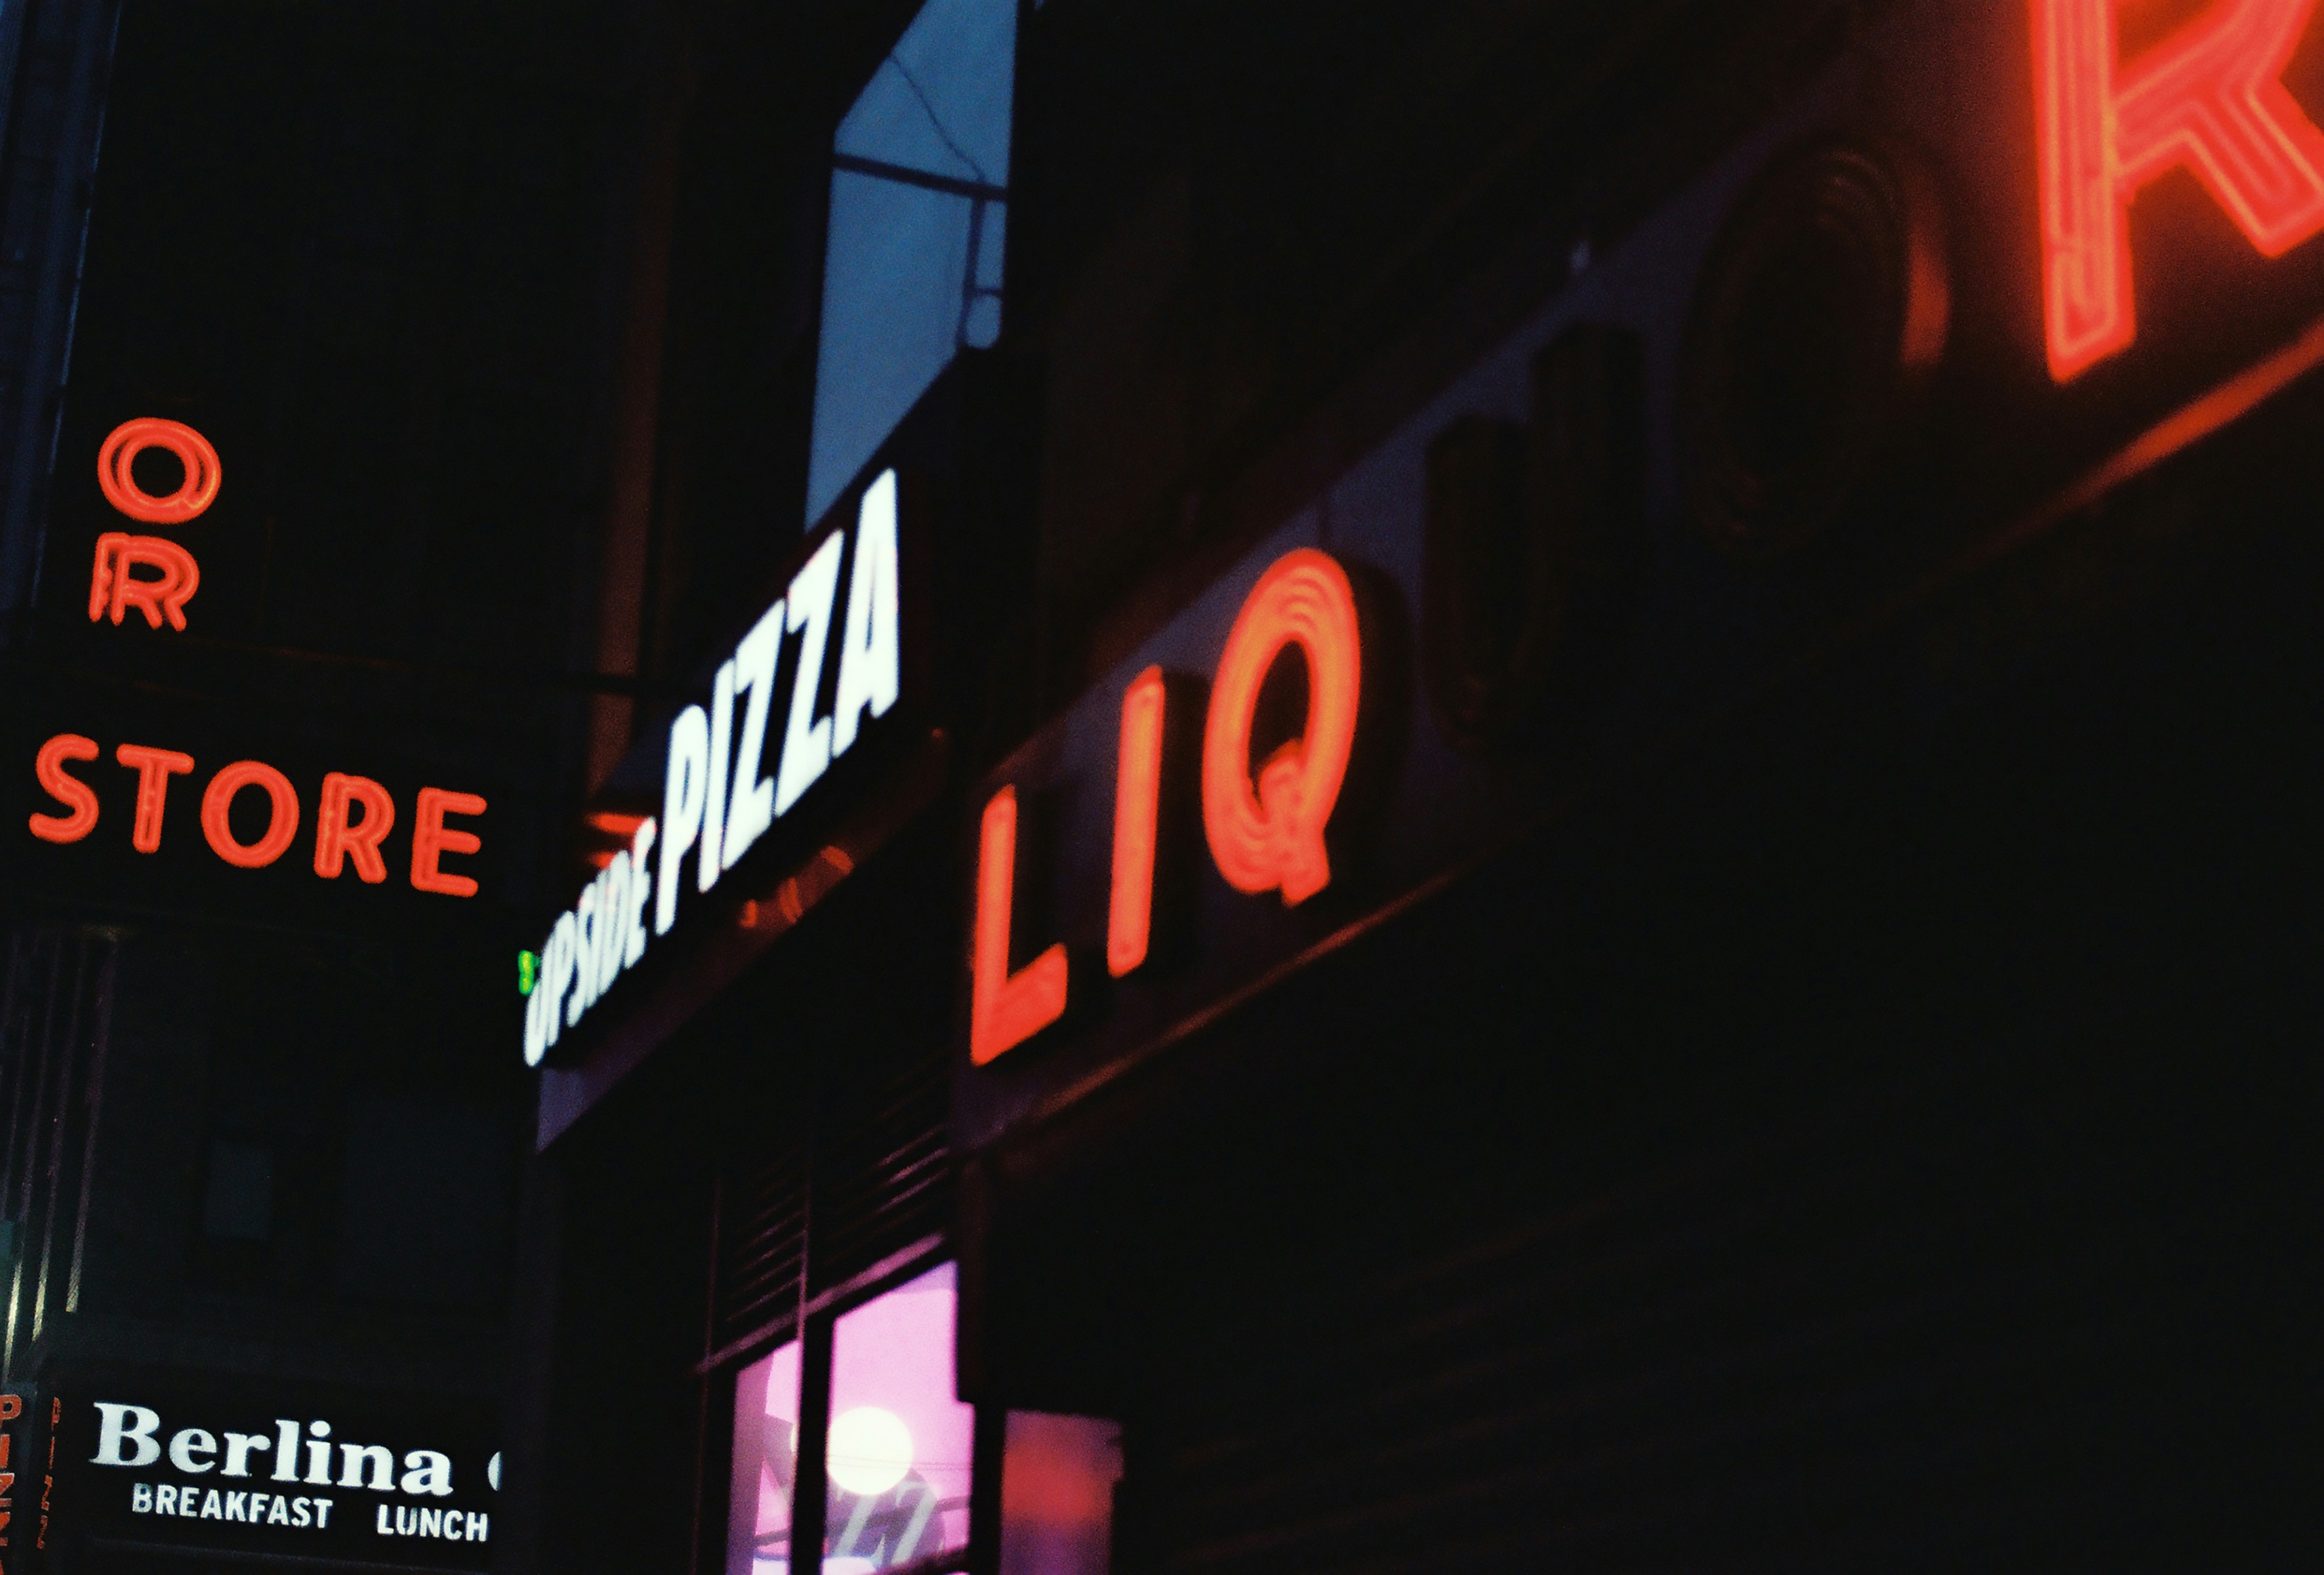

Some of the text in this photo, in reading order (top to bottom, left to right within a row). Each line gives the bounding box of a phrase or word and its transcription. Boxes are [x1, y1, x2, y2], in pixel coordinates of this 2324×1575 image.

[89, 417, 222, 632] OR
[29, 733, 487, 898] STORE
[523, 466, 899, 1067] UPSIDE PIZZA
[89, 1401, 454, 1498] Berlina
[132, 1483, 489, 1542] BREAKFAST LUNCH
